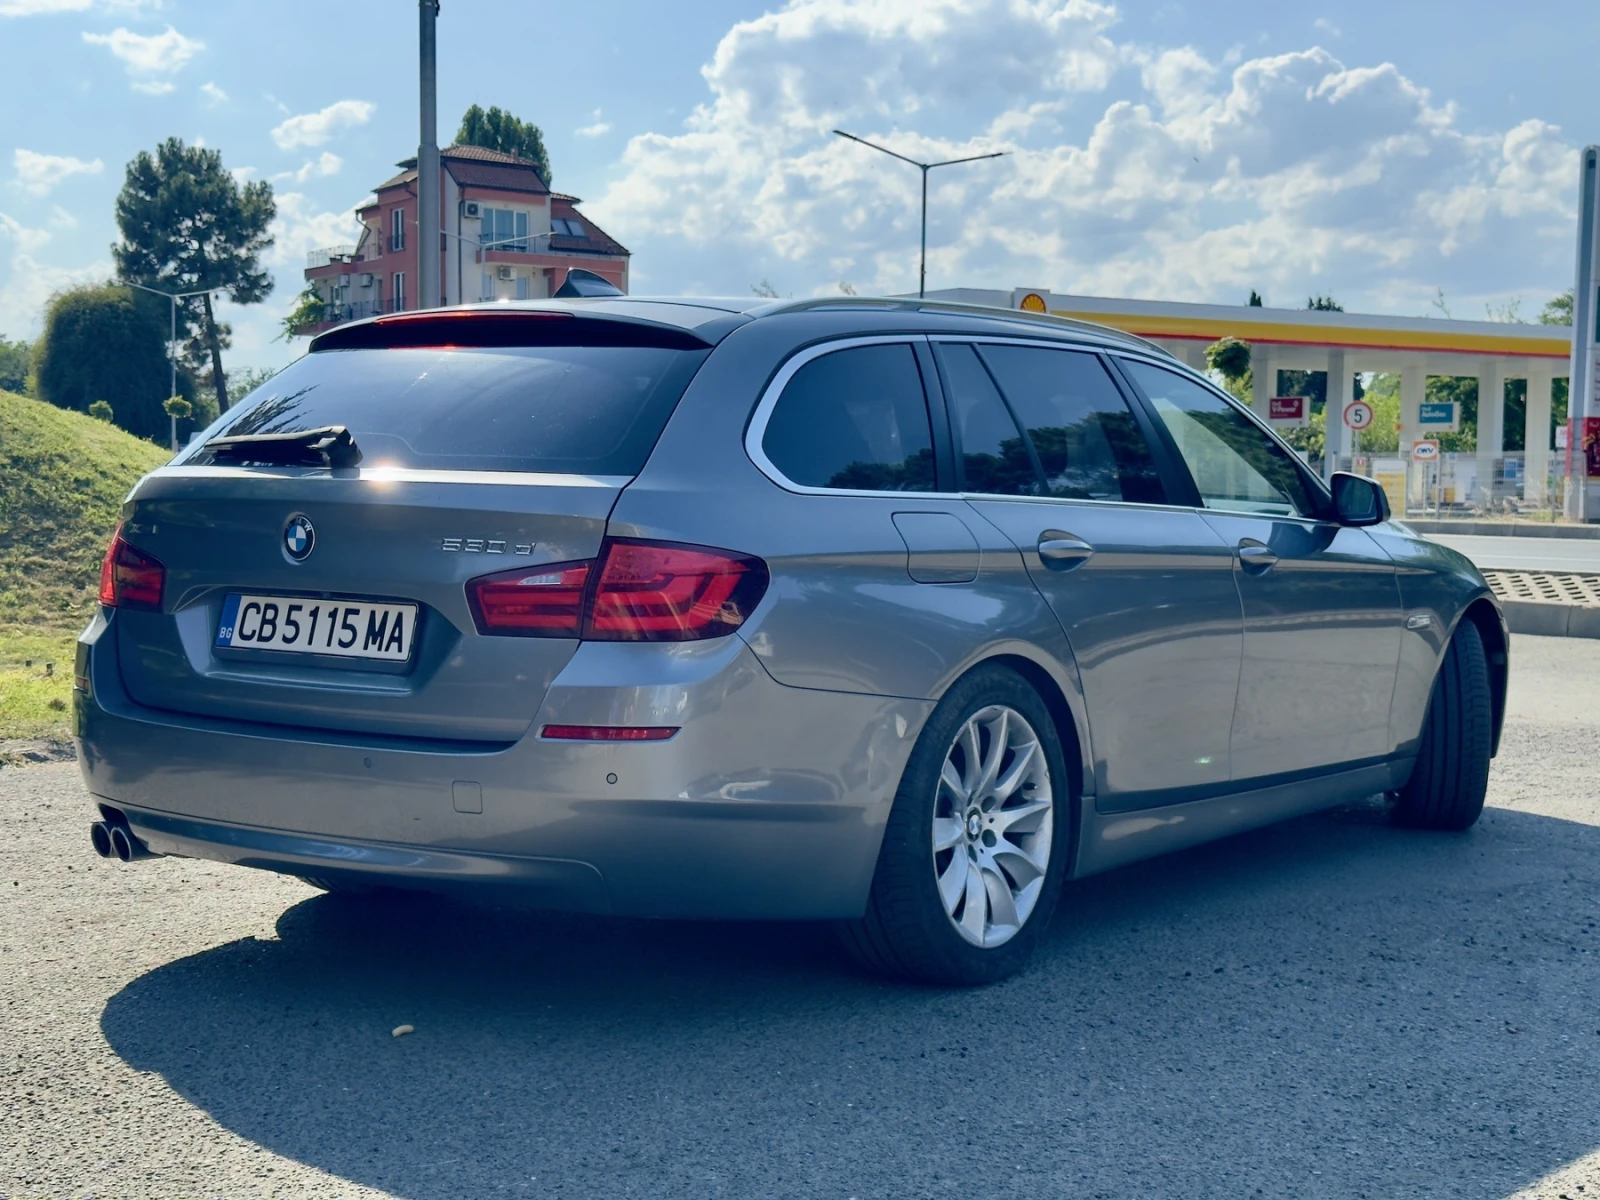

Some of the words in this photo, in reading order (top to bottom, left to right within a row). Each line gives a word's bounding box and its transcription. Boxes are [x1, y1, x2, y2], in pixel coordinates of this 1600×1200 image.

[1354, 408, 1363, 423] 5
[442, 538, 507, 554] 530
[219, 627, 233, 639] BG
